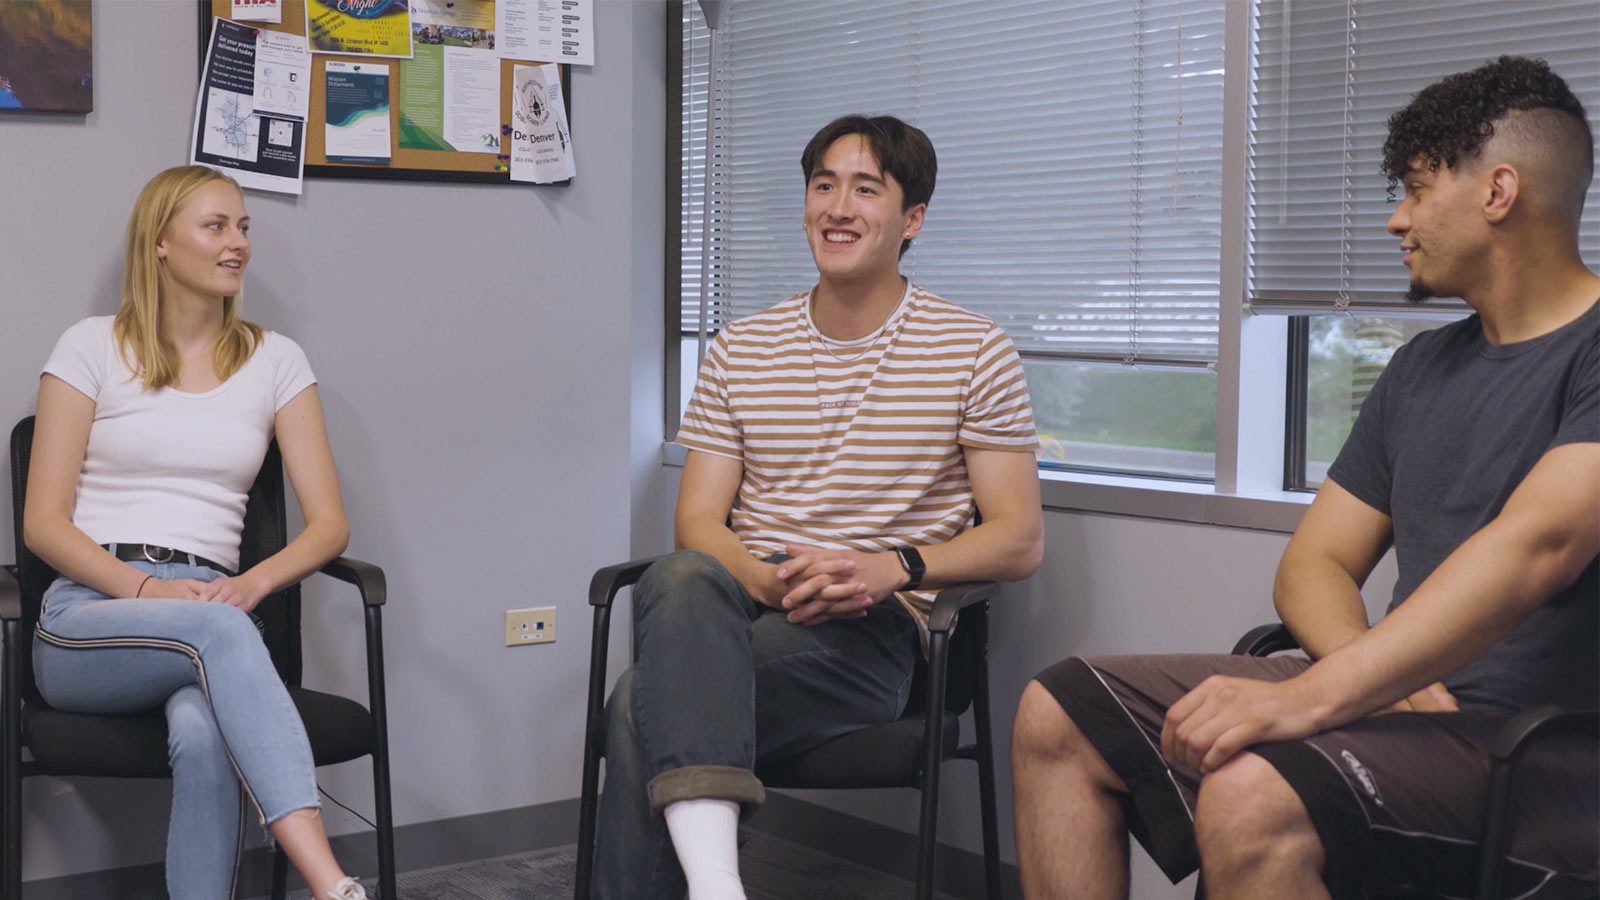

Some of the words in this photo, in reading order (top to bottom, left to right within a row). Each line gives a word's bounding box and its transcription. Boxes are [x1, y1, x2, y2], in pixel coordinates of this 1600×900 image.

[337, 0, 376, 16] Night
[217, 42, 238, 52] delivered
[239, 48, 253, 57] today
[514, 130, 527, 141] De
[530, 133, 555, 144] Denver
